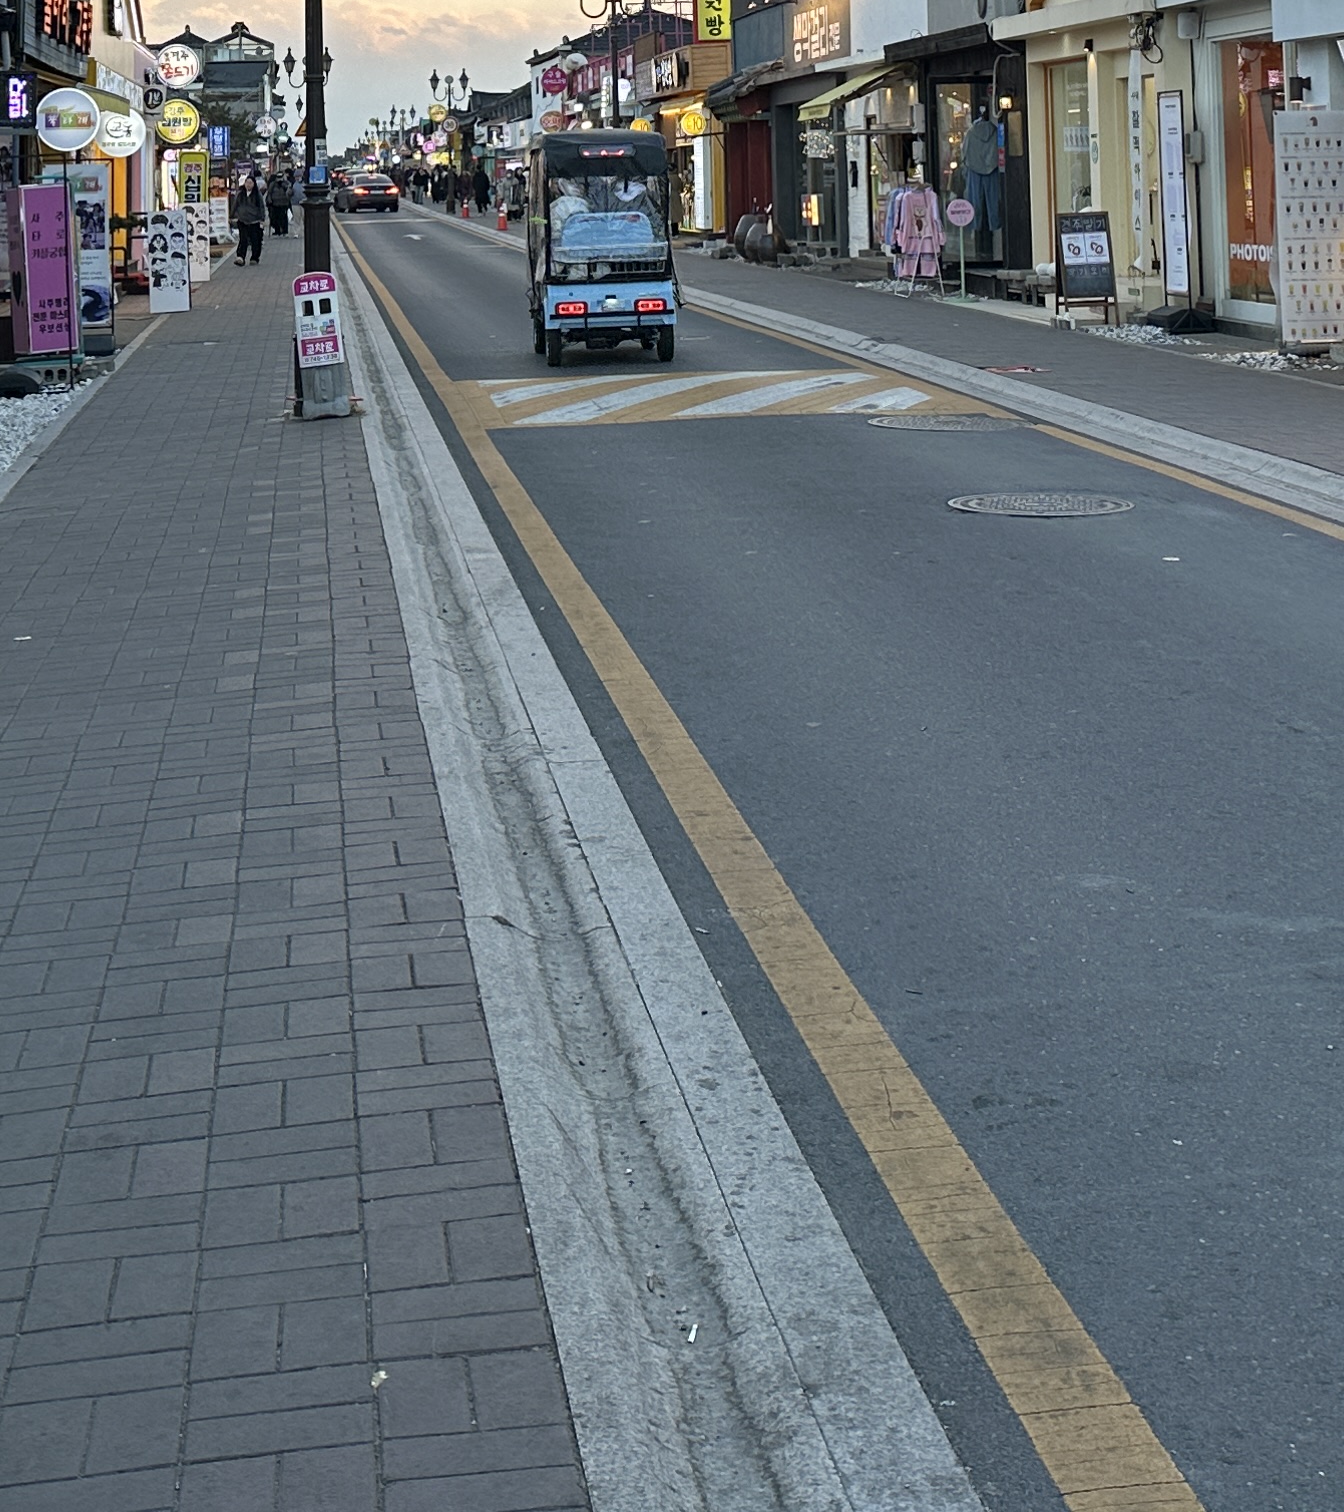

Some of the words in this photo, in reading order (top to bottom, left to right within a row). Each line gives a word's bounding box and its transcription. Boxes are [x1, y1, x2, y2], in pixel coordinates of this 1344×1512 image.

[184, 163, 203, 173] 경주
[299, 279, 330, 293] 교차로
[305, 342, 335, 355] 교차로
